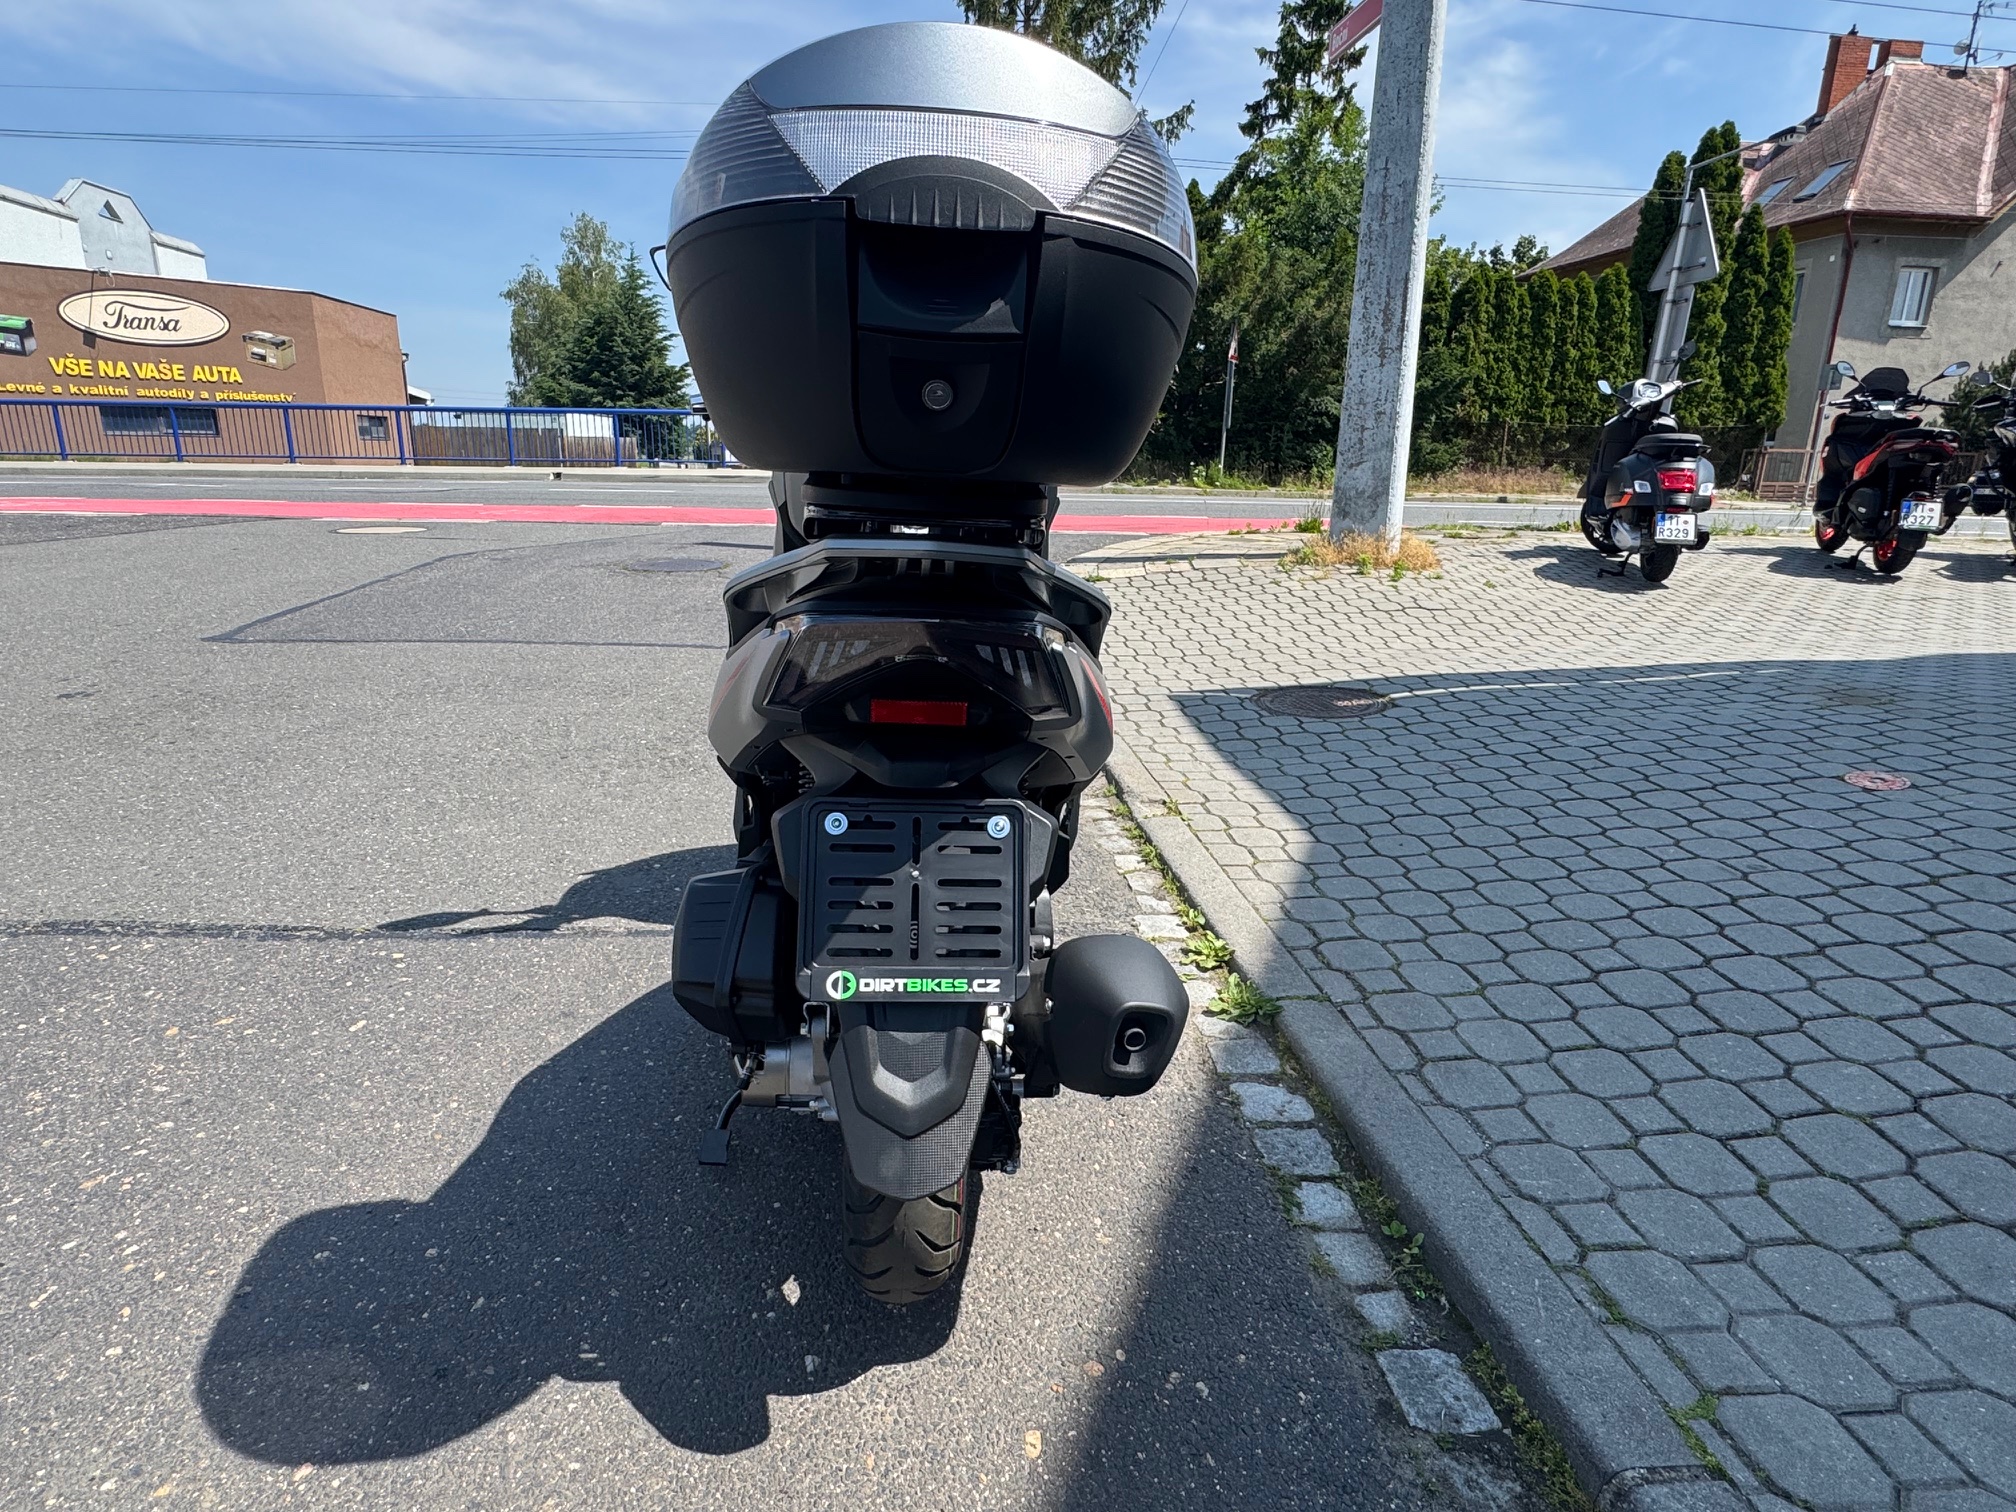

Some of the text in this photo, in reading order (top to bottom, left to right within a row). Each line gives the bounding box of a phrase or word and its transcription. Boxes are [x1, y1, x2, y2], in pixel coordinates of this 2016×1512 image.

[103, 301, 190, 332] Transa
[48, 353, 243, 384] VŠE NA VAŠE AUTA
[52, 384, 62, 394] a
[69, 384, 129, 396] kvalitní
[136, 387, 194, 400] autodíly
[200, 390, 209, 399] a
[1902, 514, 1934, 525] R327
[1658, 527, 1689, 538] R329
[859, 978, 1001, 993] DIRTBIKES.CZ
